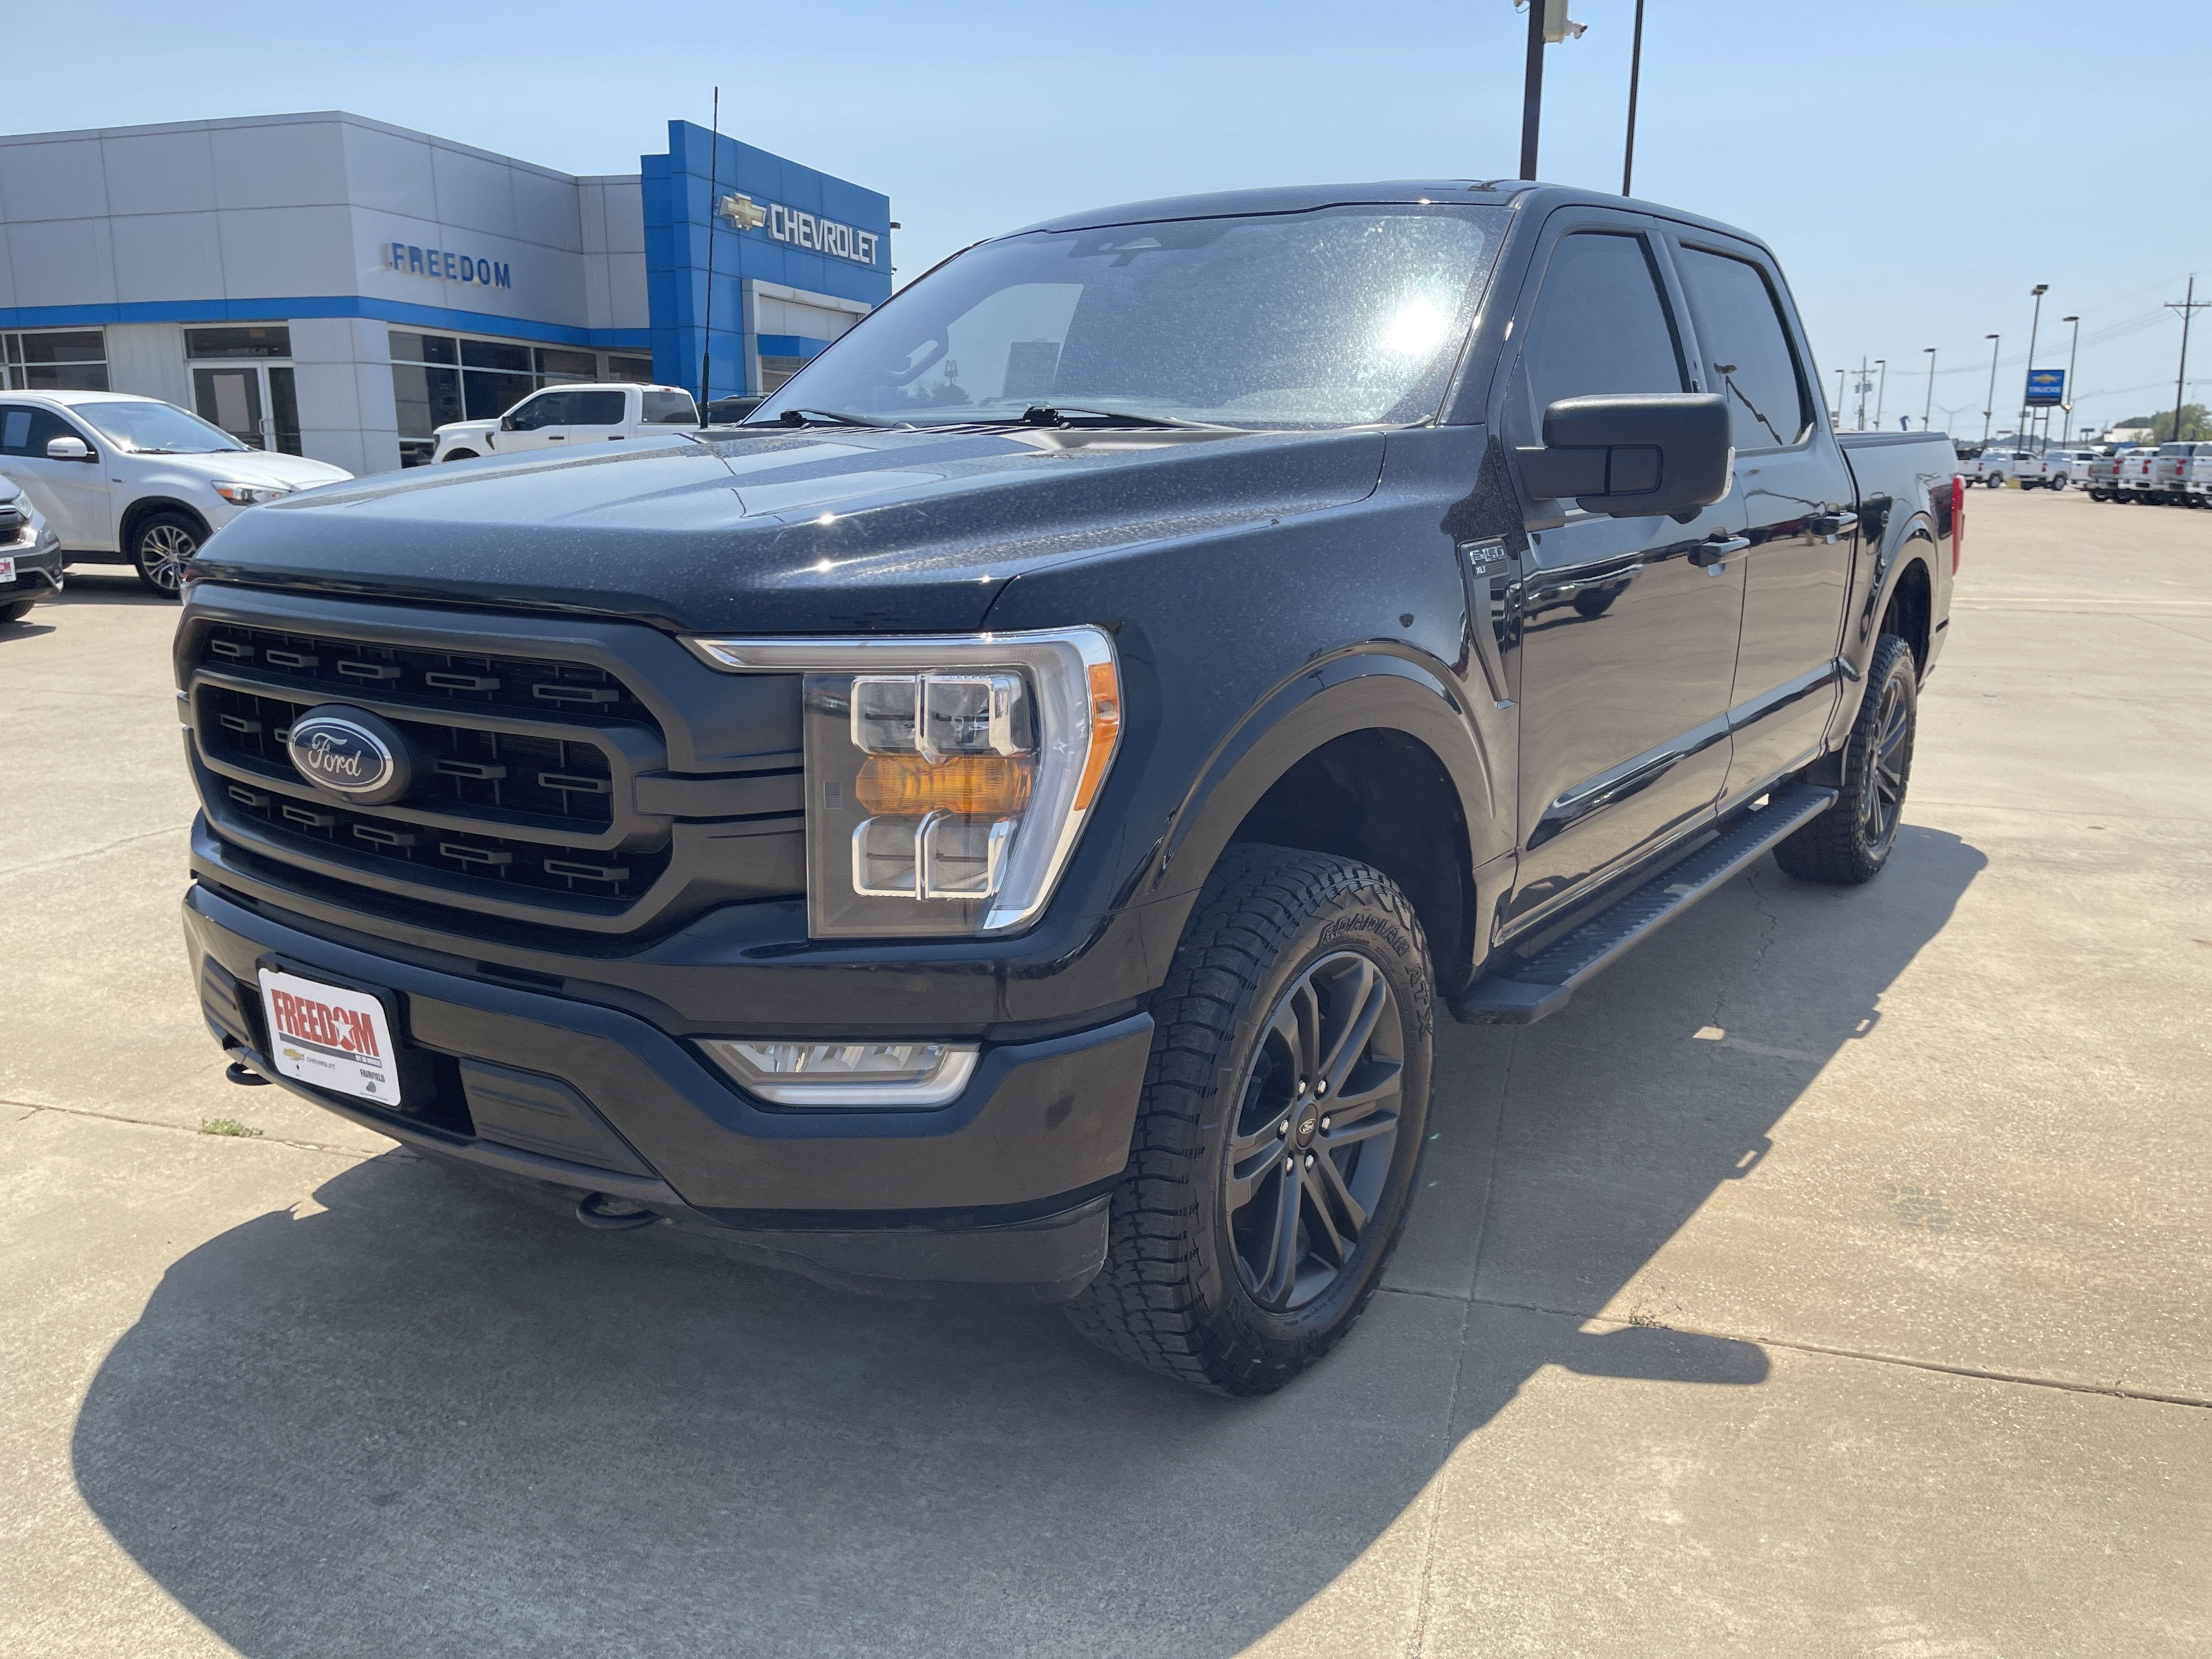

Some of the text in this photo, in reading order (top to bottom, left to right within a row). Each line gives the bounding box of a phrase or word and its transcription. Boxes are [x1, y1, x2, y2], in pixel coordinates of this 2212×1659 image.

[770, 204, 878, 265] CHEVROLET
[391, 242, 511, 289] FREEDOM
[1469, 545, 1507, 565] F-150
[1475, 566, 1486, 574] XLT
[308, 732, 362, 777] Ford
[270, 989, 380, 1057] FREEDOM
